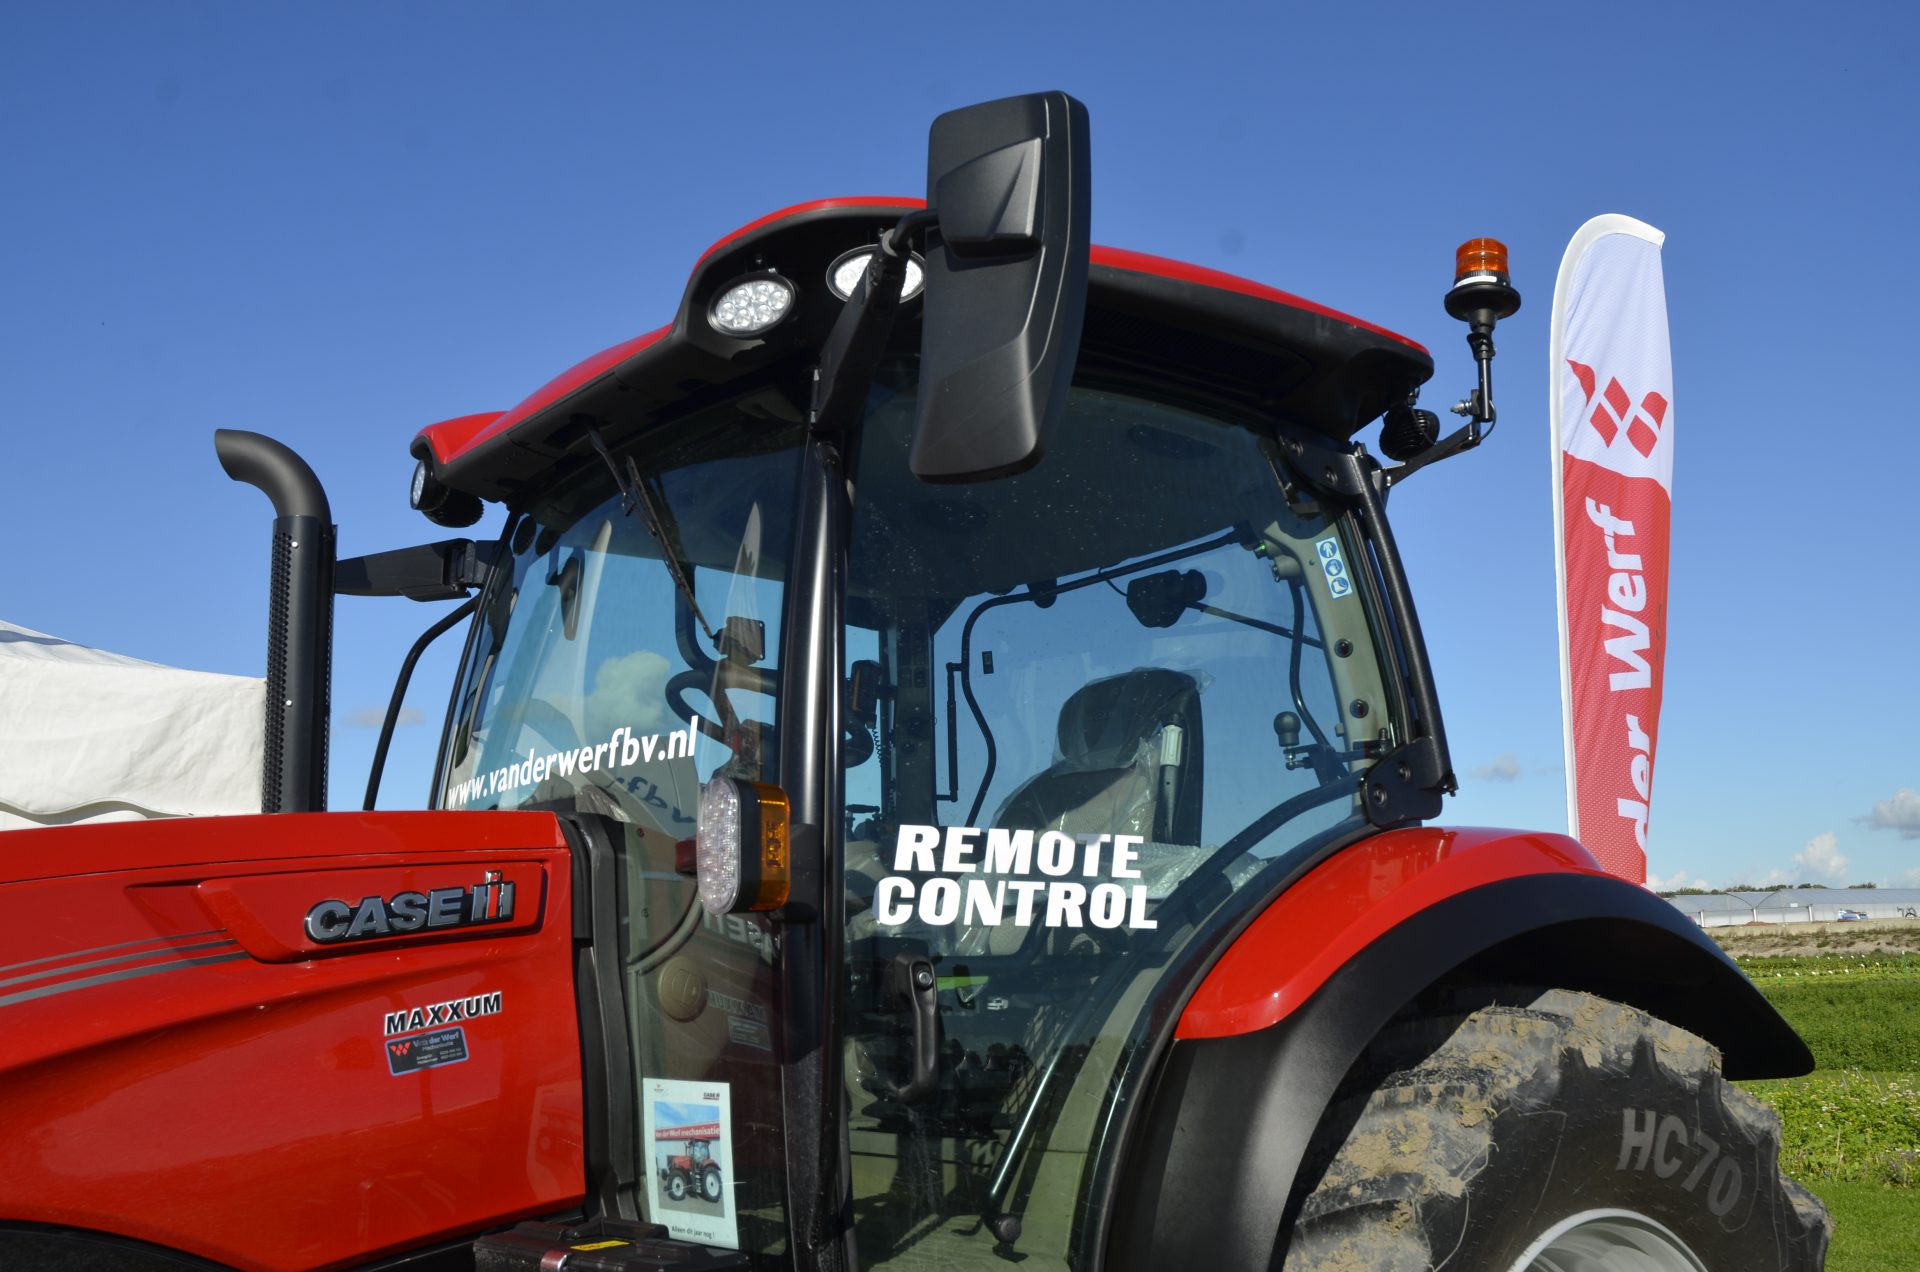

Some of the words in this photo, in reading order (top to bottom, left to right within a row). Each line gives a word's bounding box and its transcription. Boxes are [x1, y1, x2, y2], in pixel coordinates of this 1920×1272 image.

[1585, 496, 1652, 692] Werf
[448, 715, 699, 809] www.vanderwerfbv.nl
[893, 824, 1145, 879] REMOTE
[305, 886, 466, 944] CASE
[872, 876, 1158, 929] CONTROL
[384, 991, 502, 1036] MAXXUM
[441, 1031, 460, 1043] Werf
[1615, 1107, 1743, 1217] HC70
